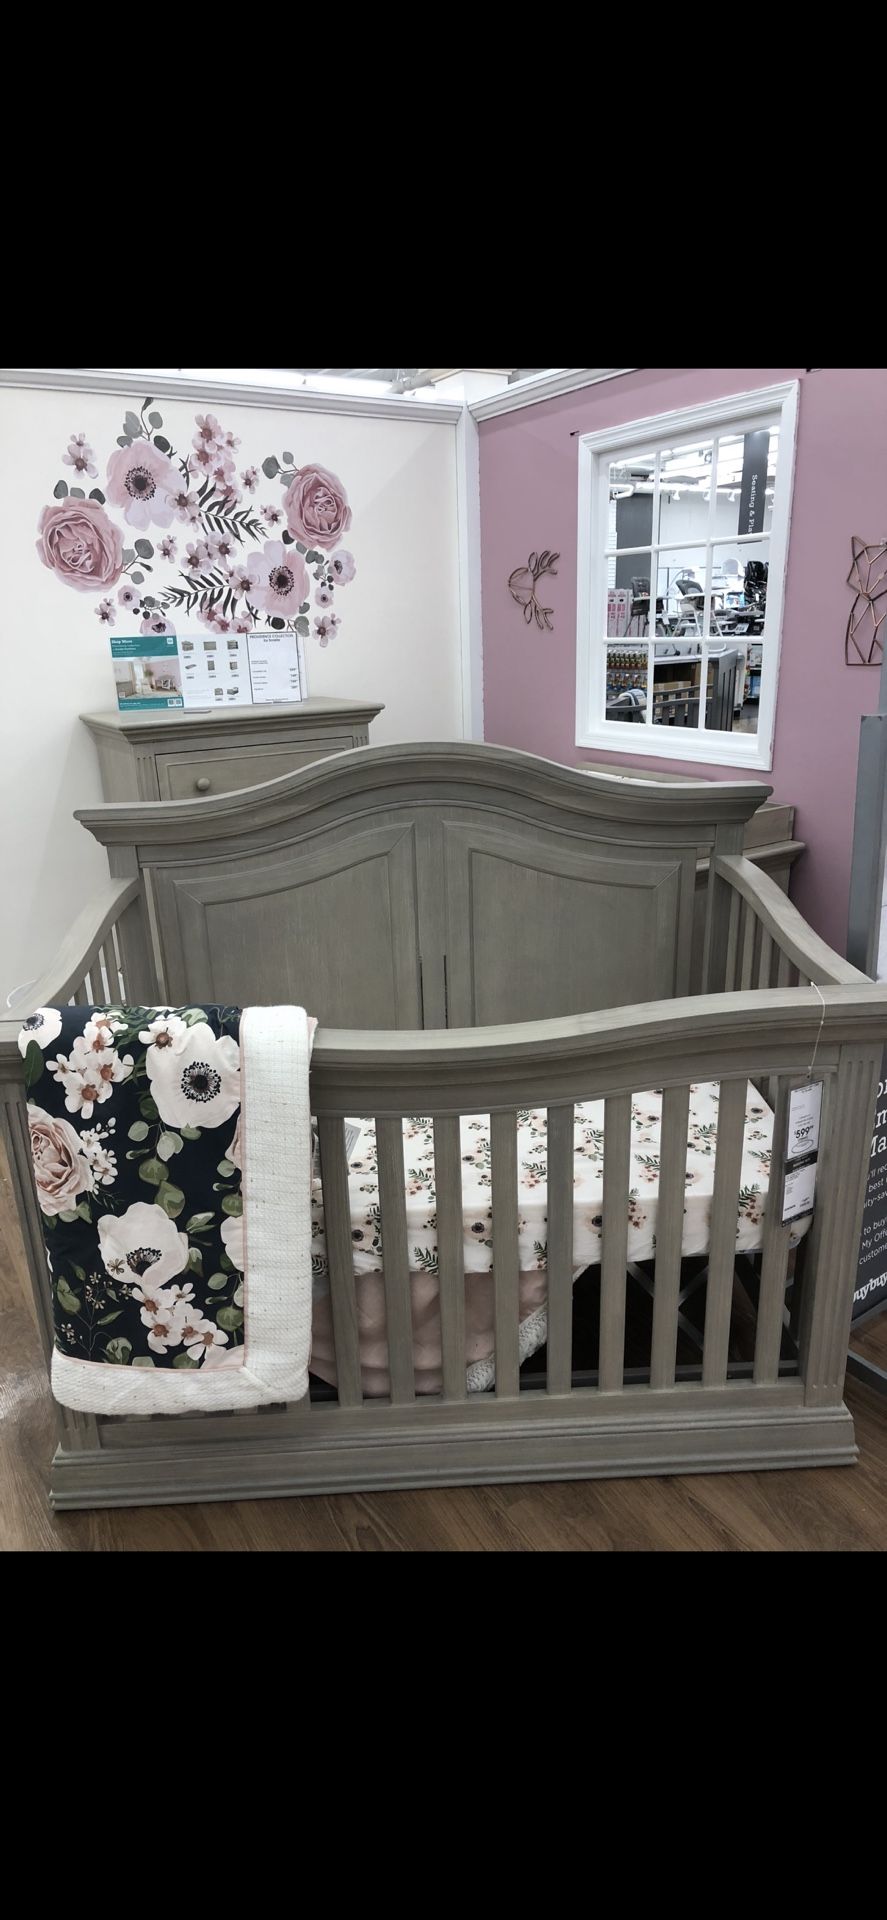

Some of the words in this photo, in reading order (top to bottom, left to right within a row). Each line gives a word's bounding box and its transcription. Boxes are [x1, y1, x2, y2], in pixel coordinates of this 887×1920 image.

[748, 474, 758, 508] Seating
[747, 517, 755, 533] Pla
[868, 1178, 884, 1192] best
[863, 1226, 872, 1236] to
[862, 1238, 873, 1250] My
